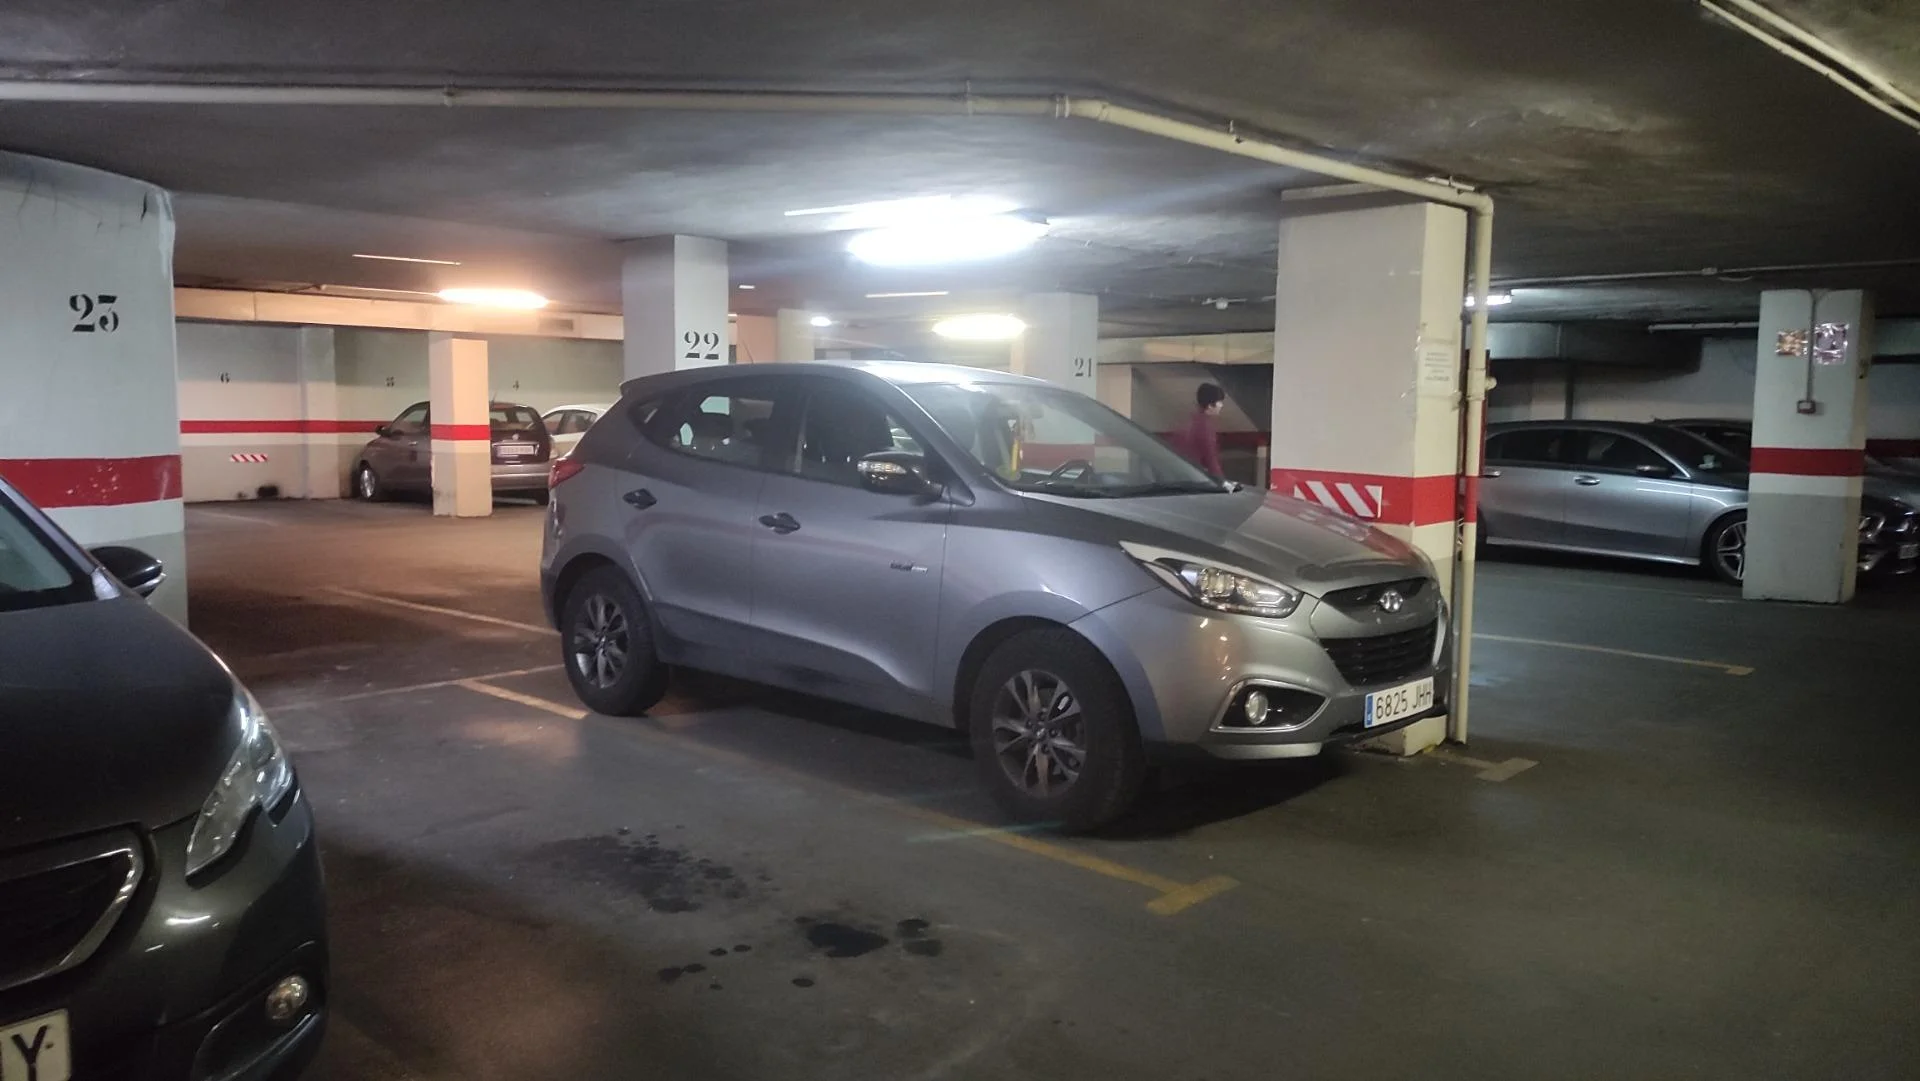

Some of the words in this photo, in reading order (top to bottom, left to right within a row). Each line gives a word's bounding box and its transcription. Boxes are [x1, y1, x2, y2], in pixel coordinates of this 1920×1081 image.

[69, 294, 119, 332] 23
[684, 331, 720, 360] 22
[1074, 357, 1092, 377] 21
[1376, 689, 1409, 720] 6825
[1412, 680, 1433, 709] JHH
[0, 1024, 48, 1081] Y
